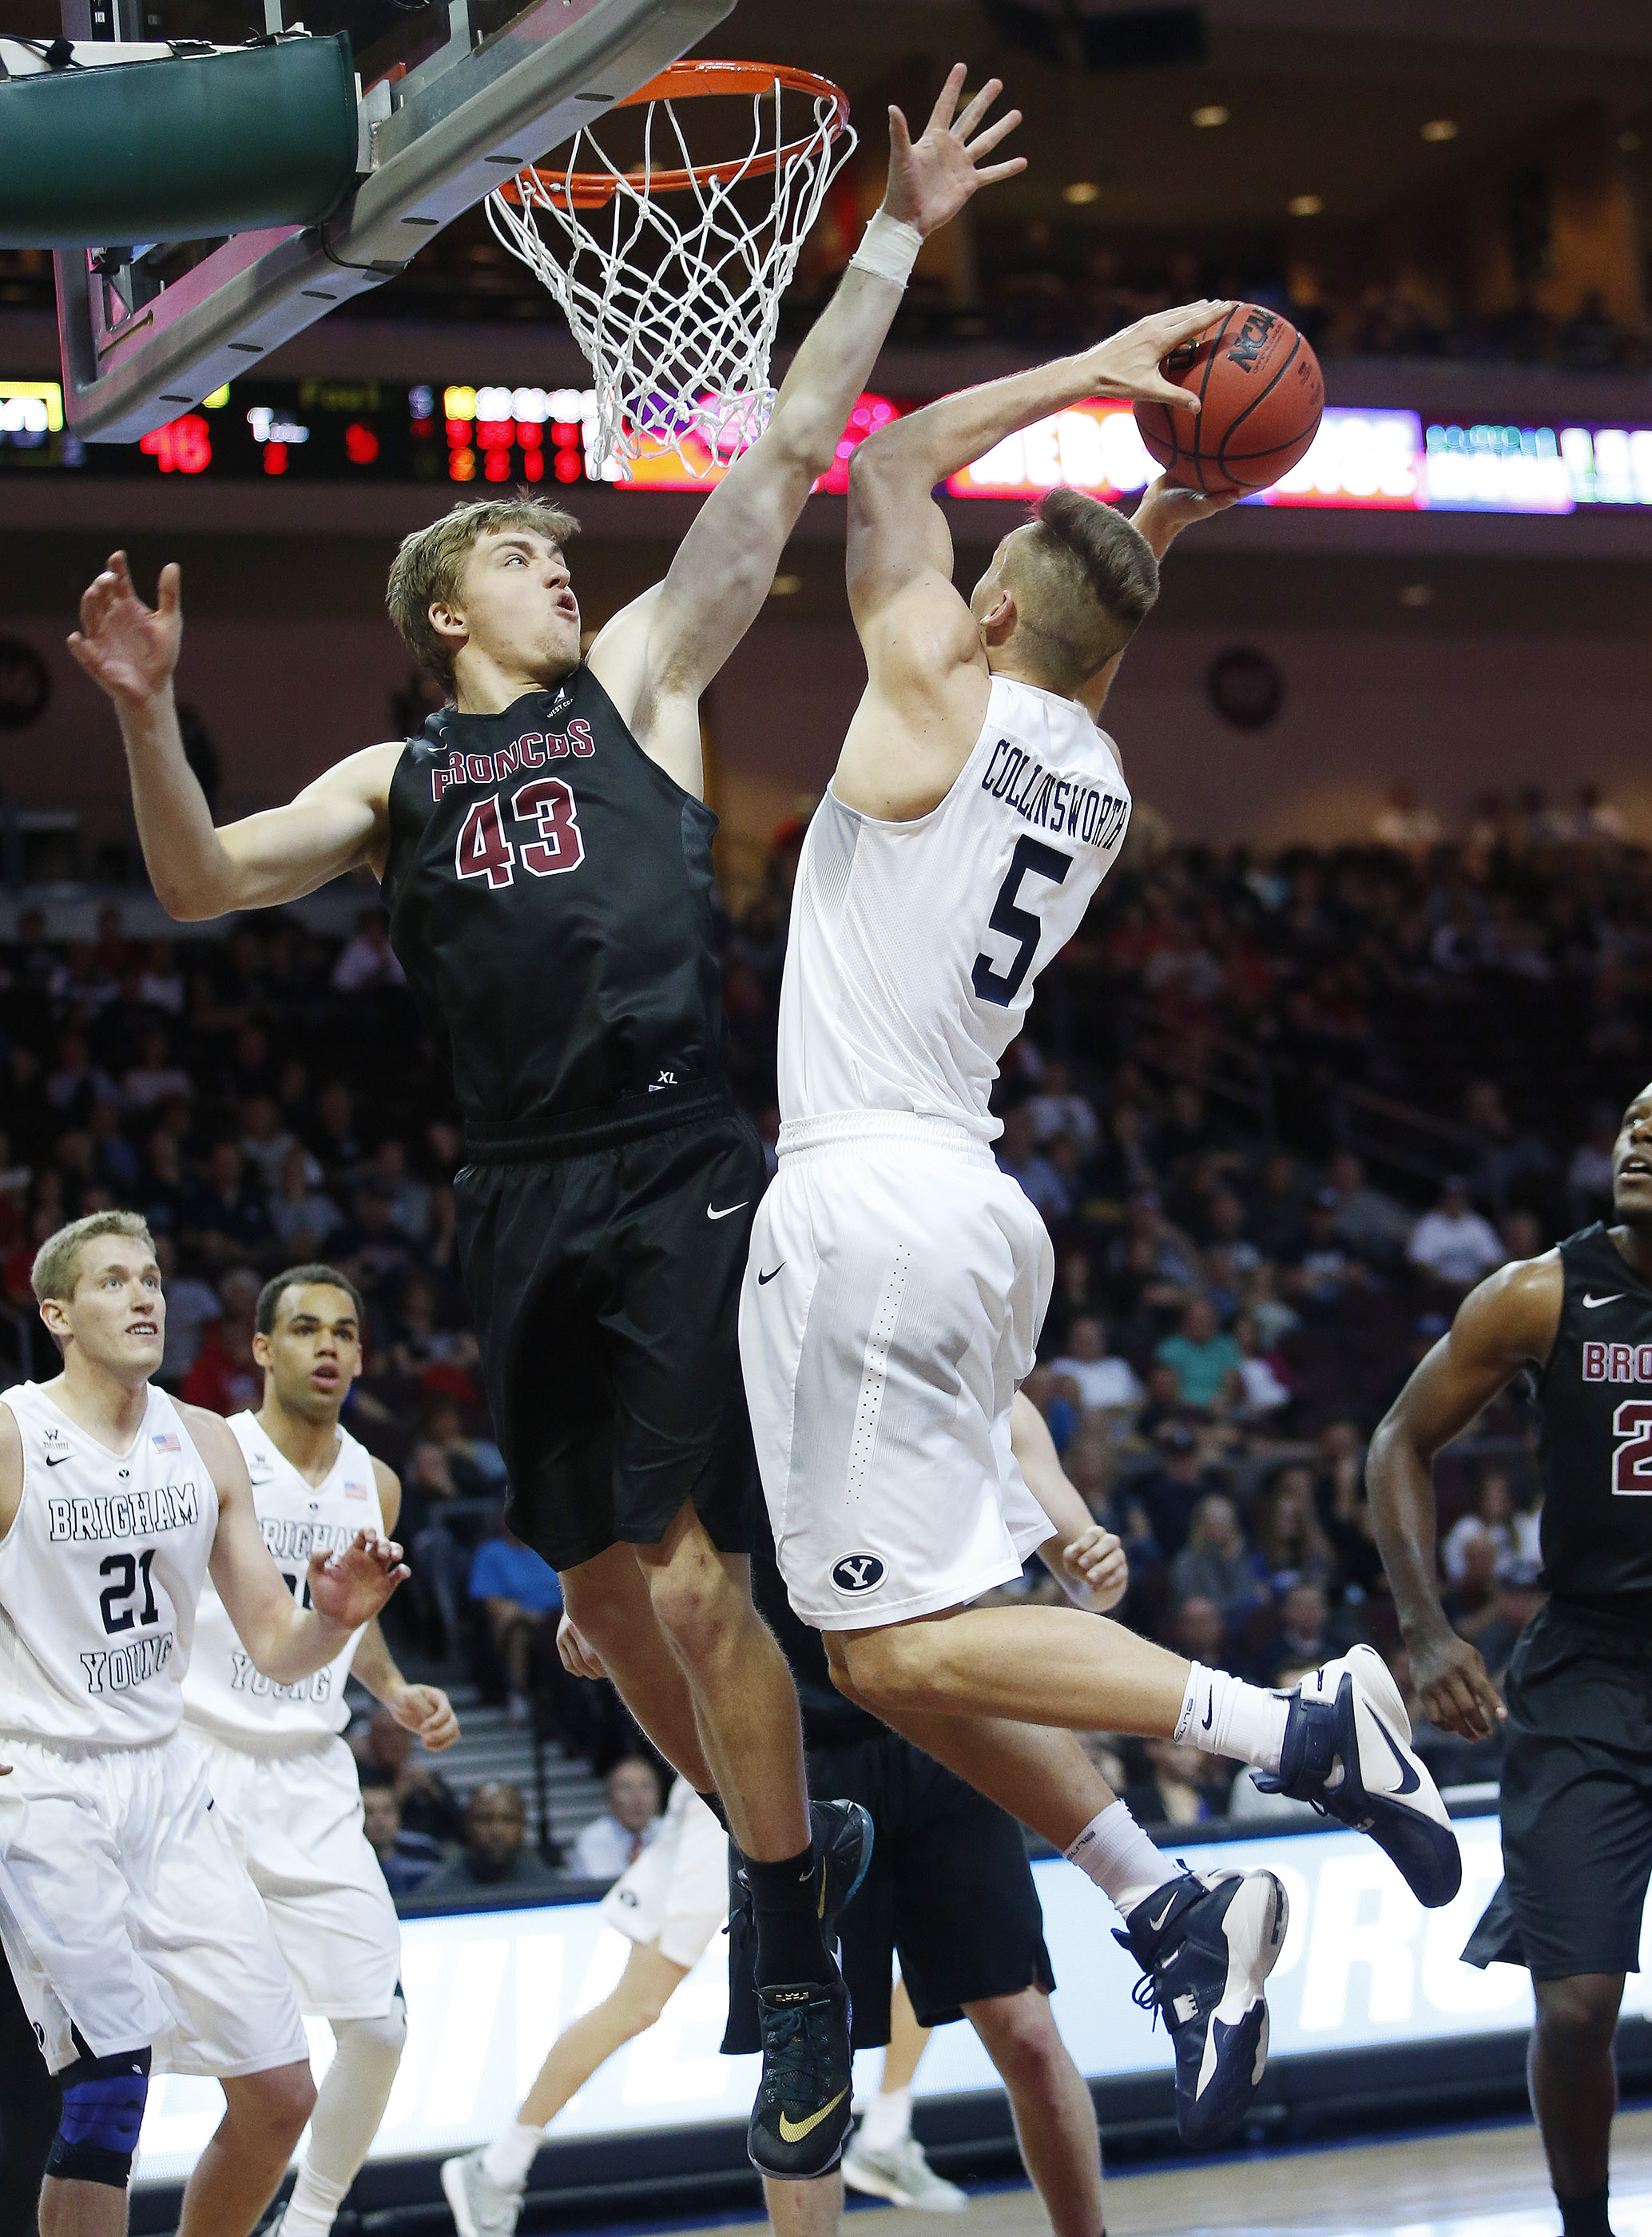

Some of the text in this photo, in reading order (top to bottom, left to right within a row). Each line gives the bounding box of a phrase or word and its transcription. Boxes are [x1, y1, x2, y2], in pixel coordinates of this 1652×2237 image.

[546, 704, 562, 718] WEST
[431, 718, 596, 802] BRONCOS
[455, 777, 587, 890] 43
[971, 833, 1074, 1008] 5
[657, 1071, 678, 1084] XL
[49, 1483, 199, 1541] BRIGHAM
[259, 1518, 361, 1563] RIGHA
[99, 1549, 159, 1635] 21
[80, 1632, 173, 1694] YOUNG
